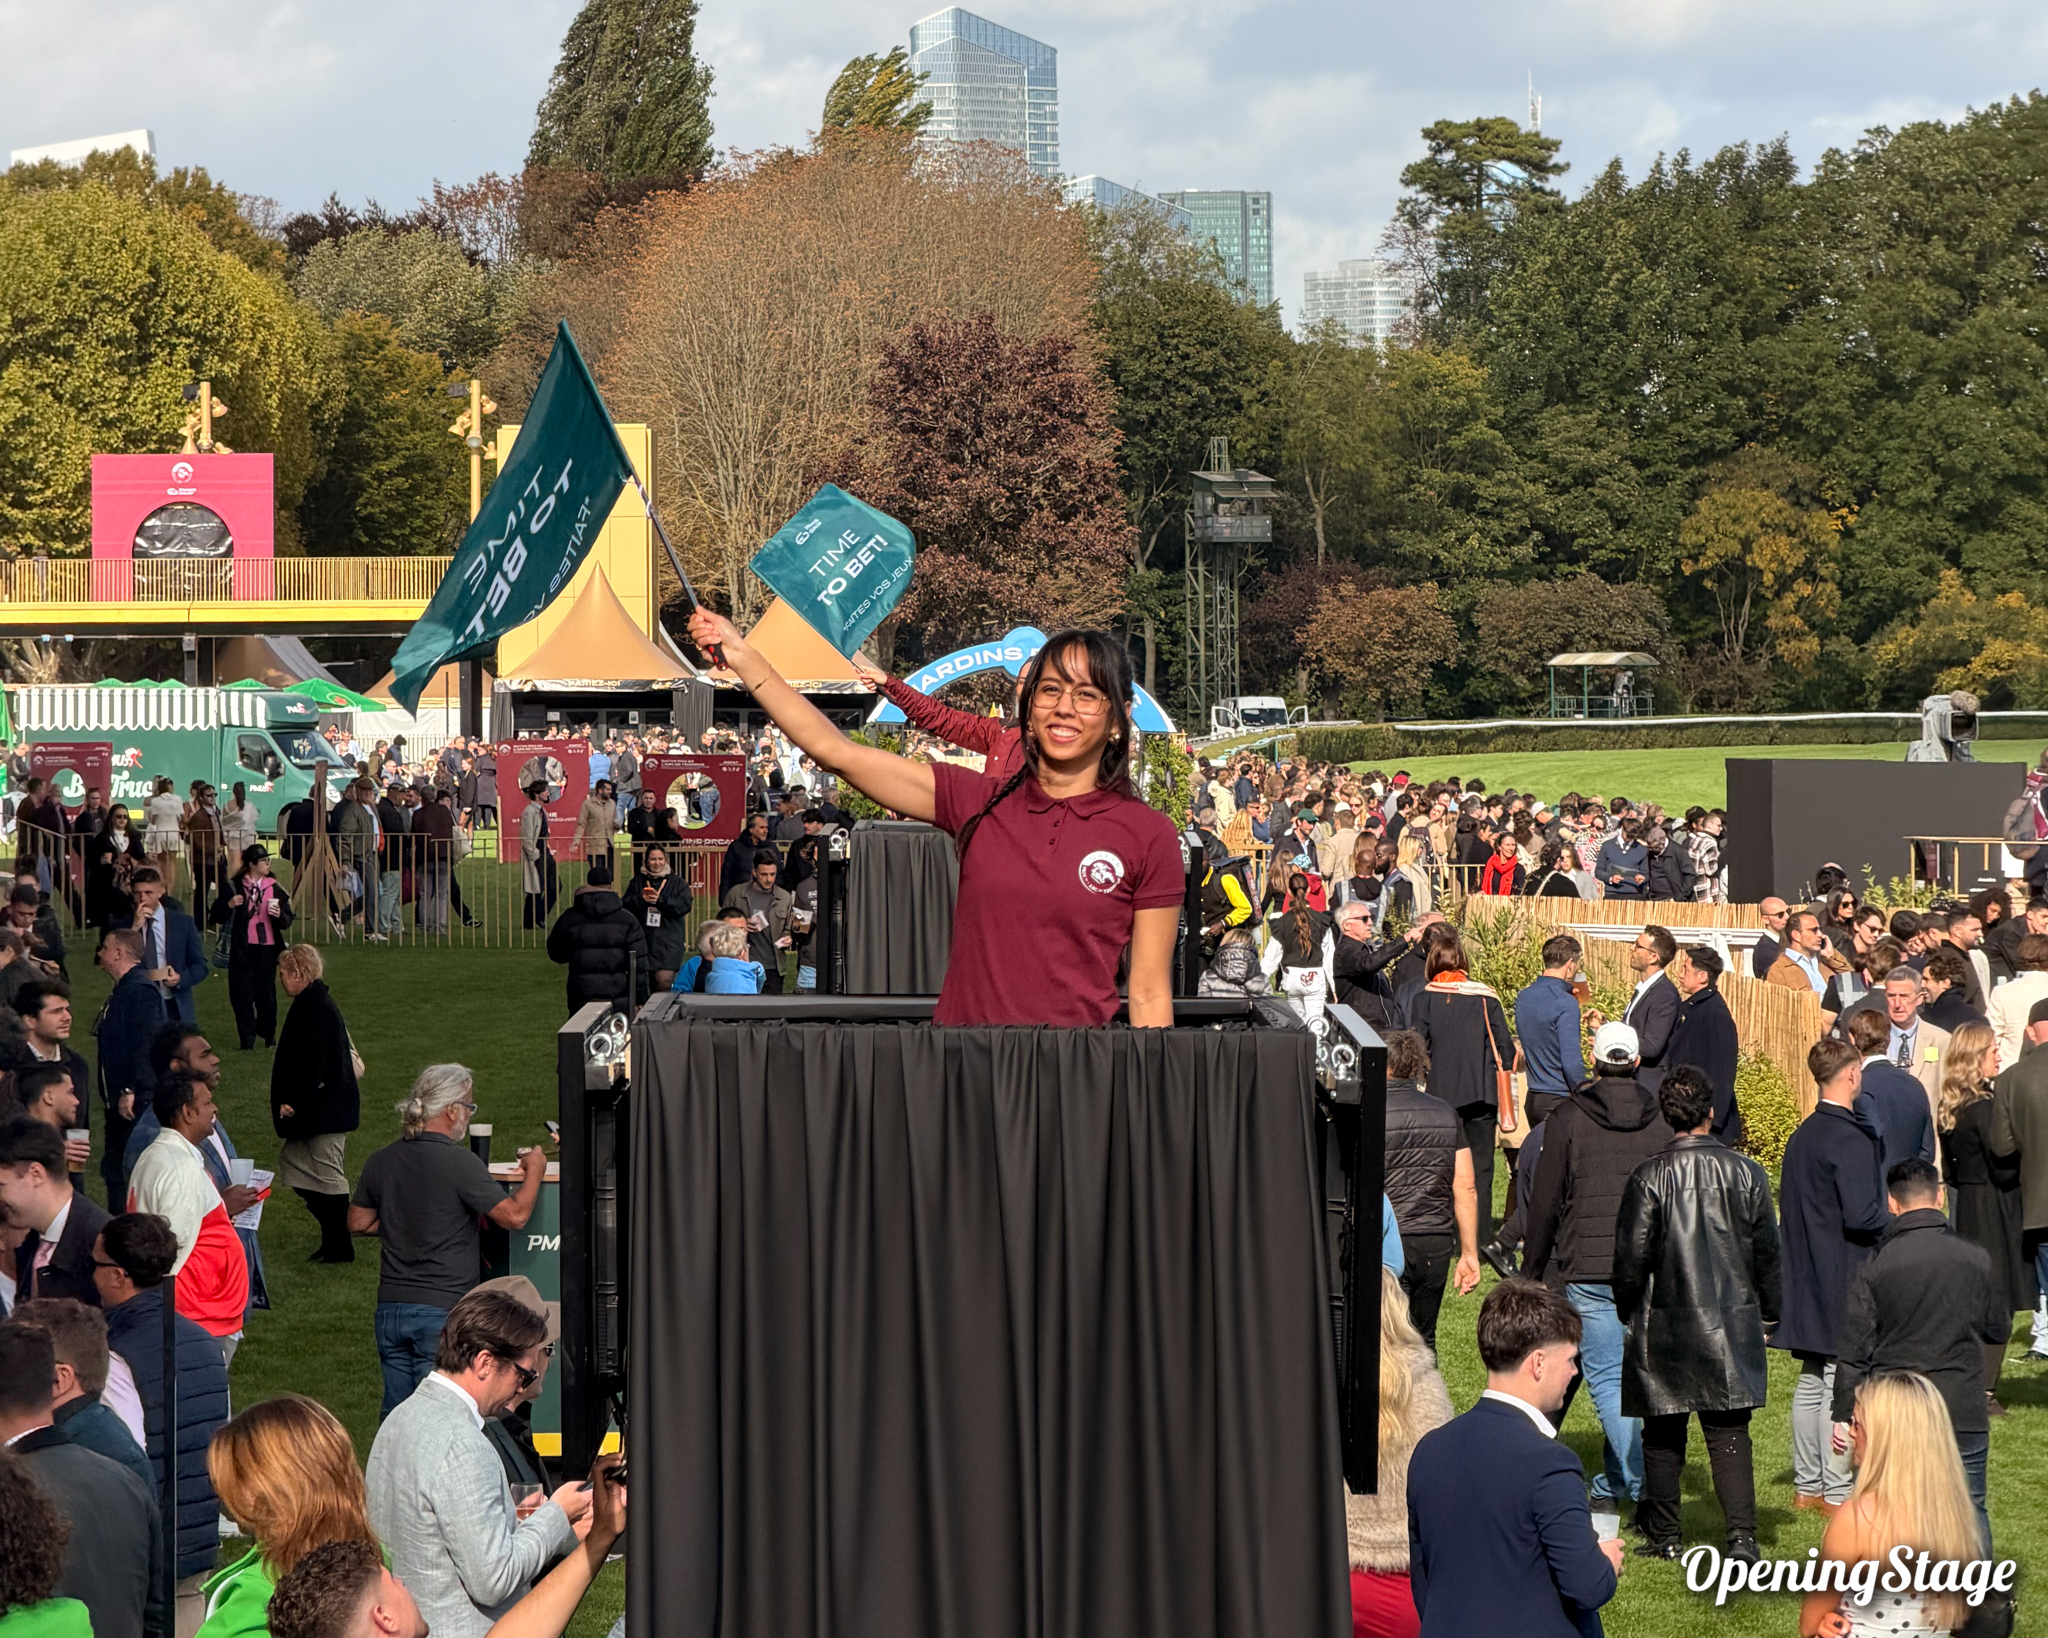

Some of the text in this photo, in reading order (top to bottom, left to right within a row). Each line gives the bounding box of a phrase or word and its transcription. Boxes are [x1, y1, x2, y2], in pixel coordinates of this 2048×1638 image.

[808, 529, 861, 577] TIME
[817, 534, 889, 606] TO BET!
[869, 579, 891, 600] VOS
[891, 556, 914, 582] JEUX
[912, 647, 1023, 693] ARDINS
[111, 770, 153, 798] Truc
[527, 1234, 561, 1251] PM
